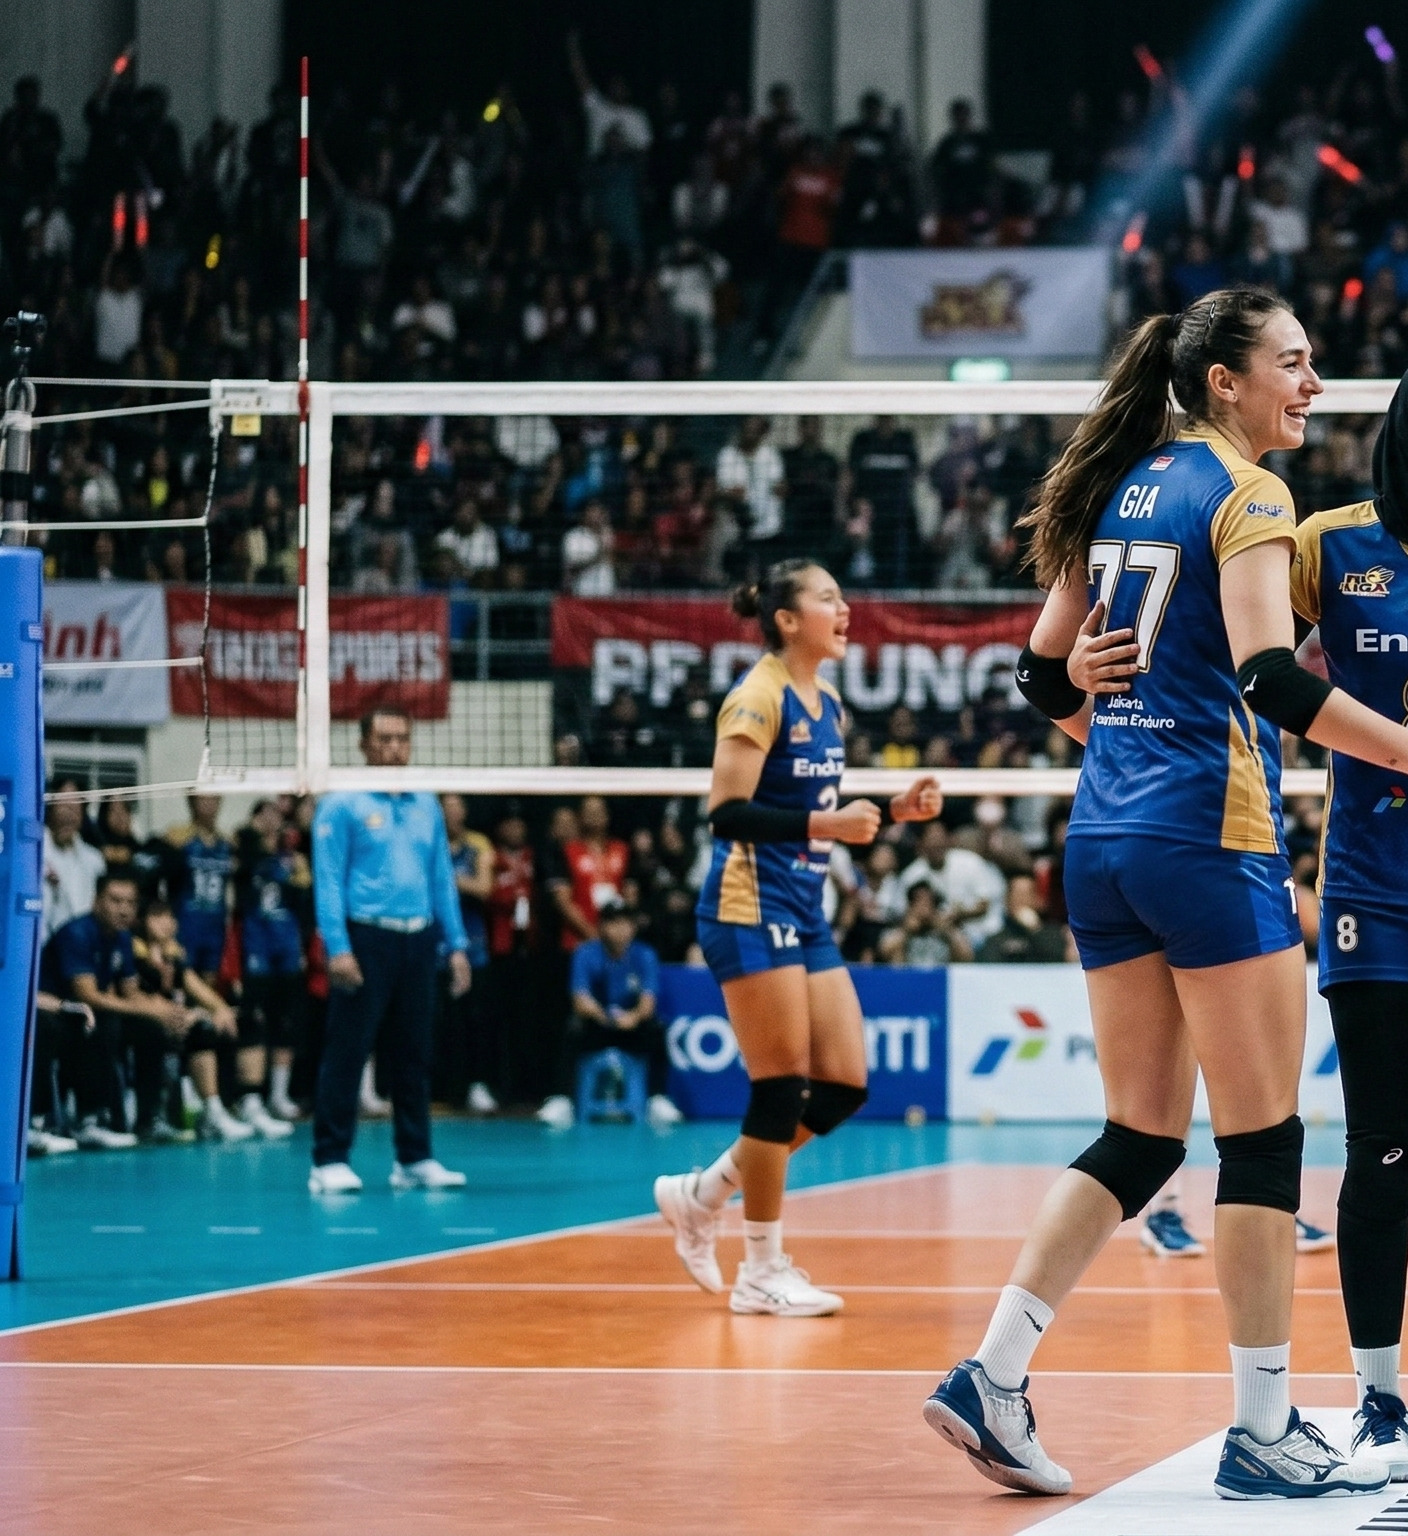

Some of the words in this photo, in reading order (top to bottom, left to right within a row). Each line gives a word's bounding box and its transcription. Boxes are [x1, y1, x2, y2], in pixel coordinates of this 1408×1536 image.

[1118, 484, 1161, 519] GIA
[1129, 713, 1176, 730] Enduro
[768, 922, 799, 948] 12
[1336, 913, 1359, 952] 8
